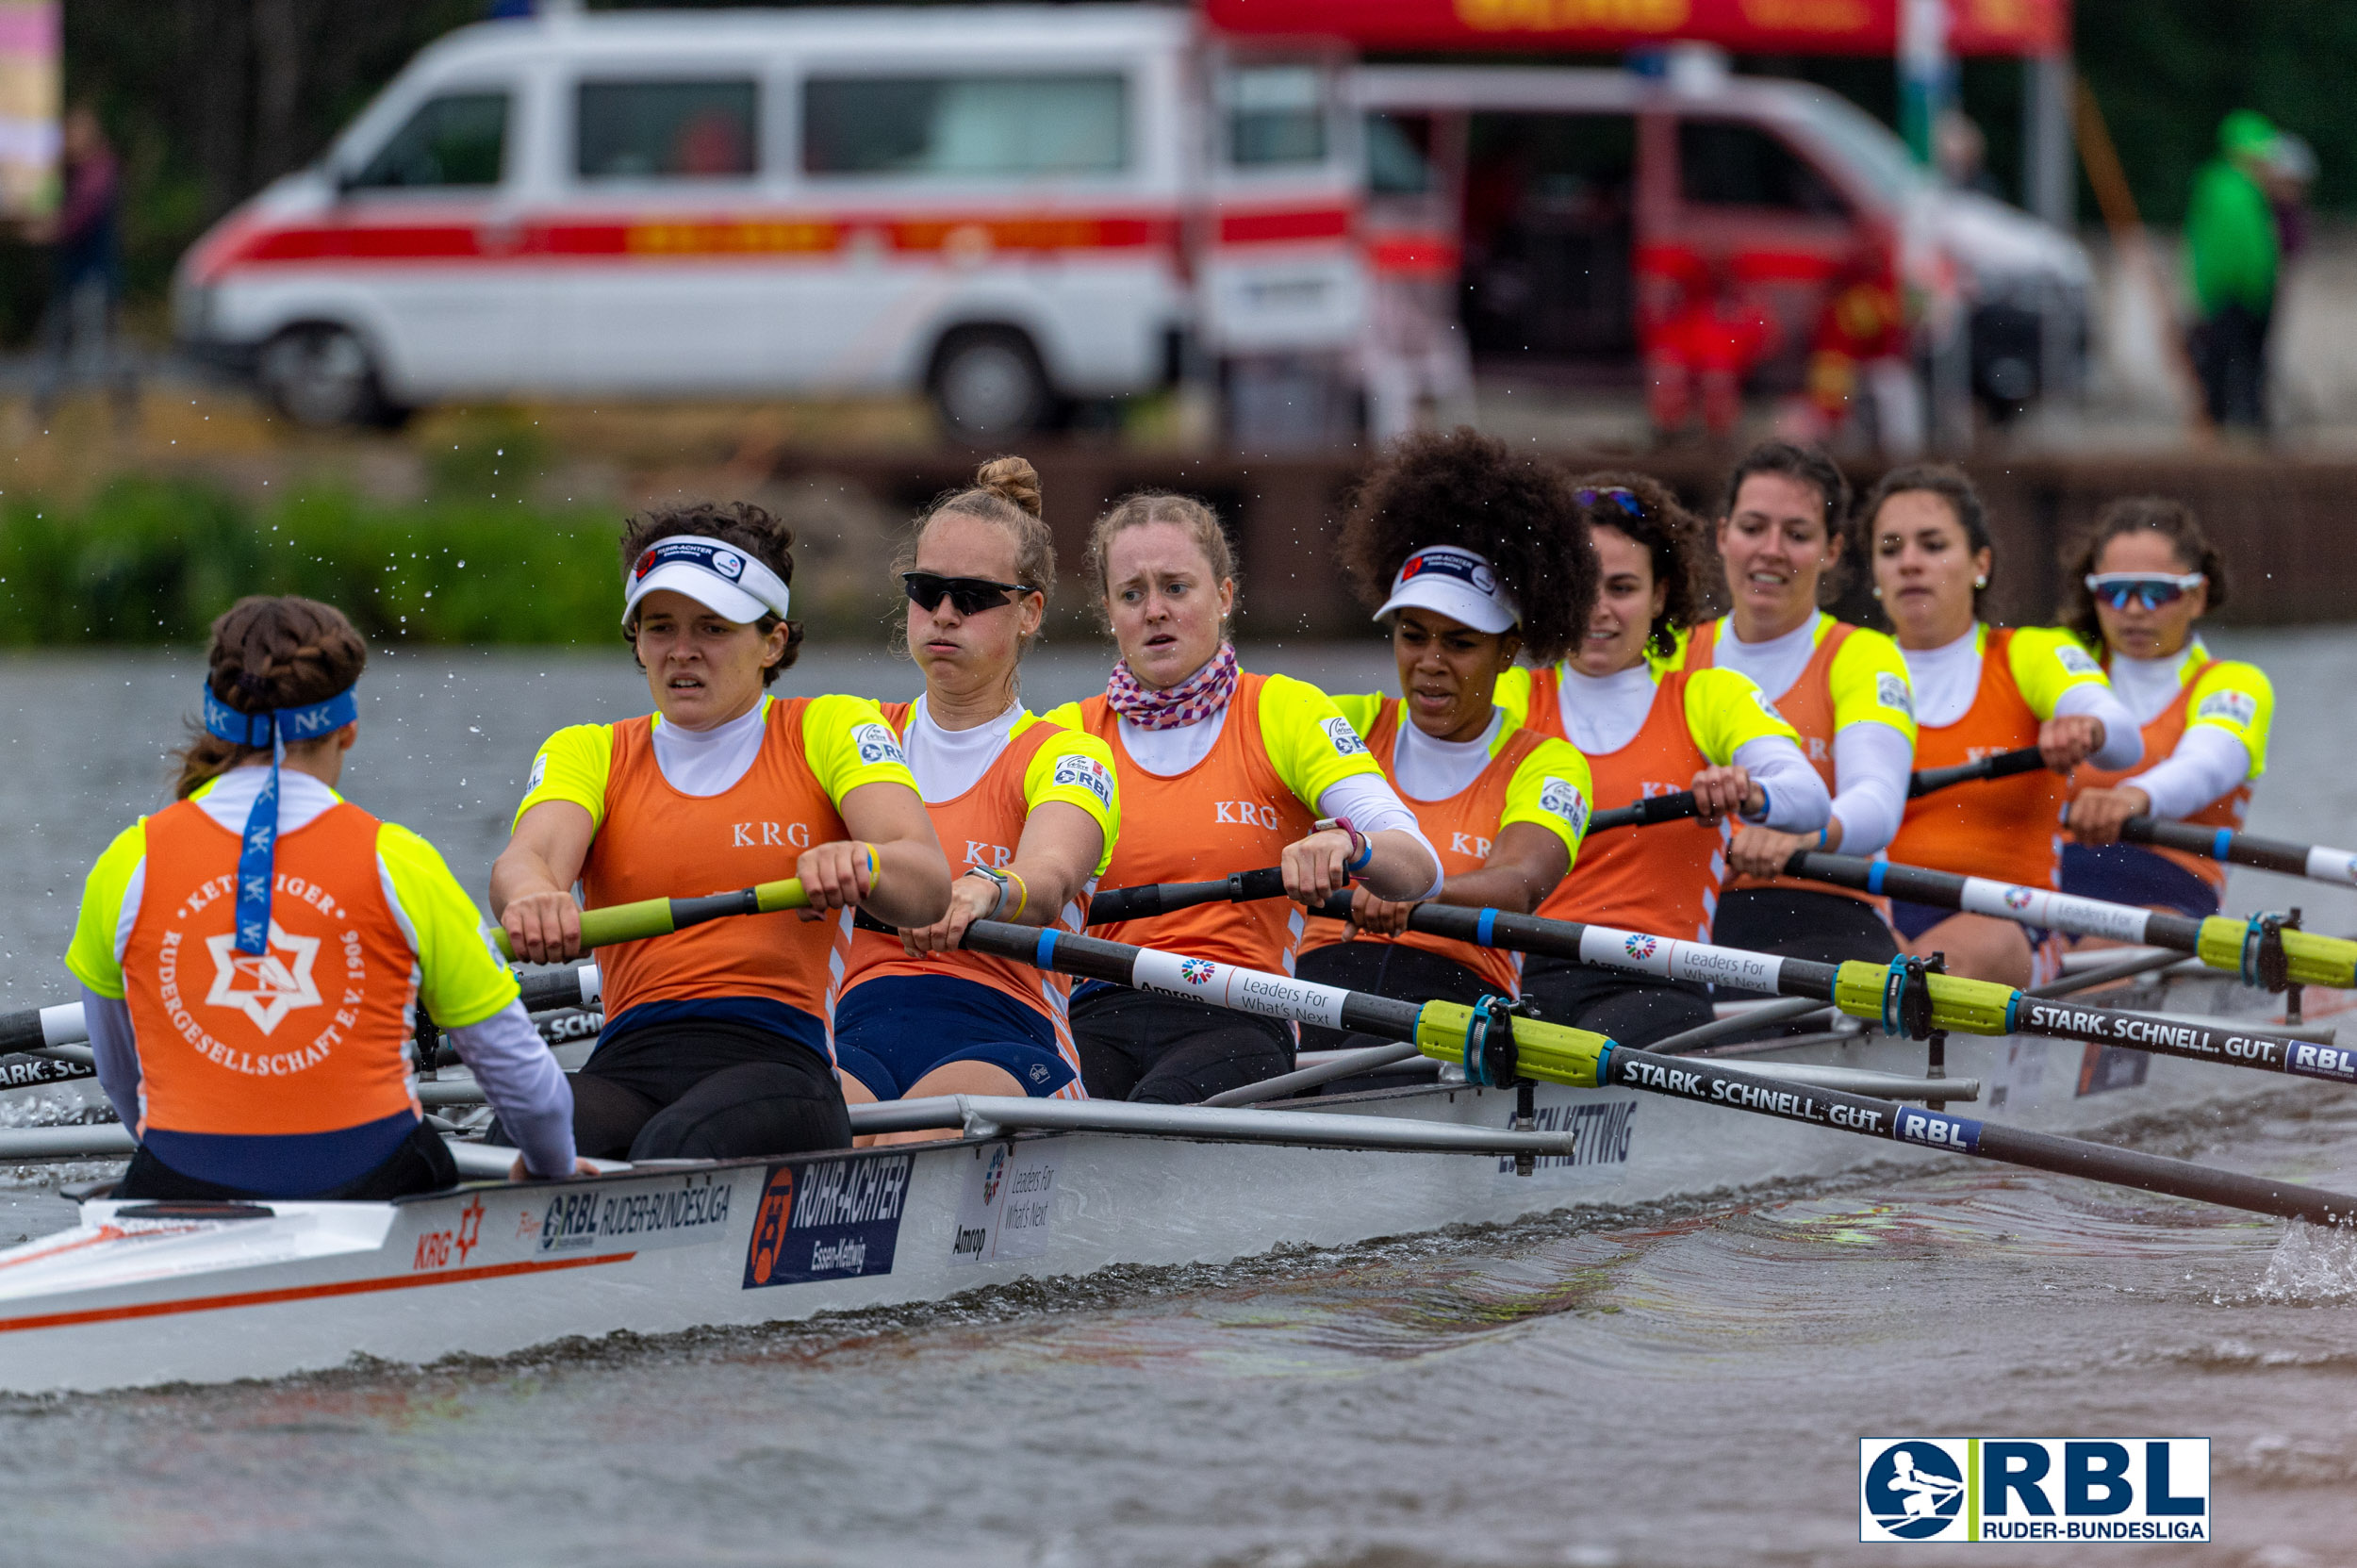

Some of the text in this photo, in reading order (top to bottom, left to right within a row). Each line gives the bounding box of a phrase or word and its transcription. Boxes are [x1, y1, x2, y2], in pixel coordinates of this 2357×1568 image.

[294, 706, 331, 733] NK
[1214, 801, 1278, 831] KRG
[732, 821, 810, 848] KRG
[1449, 831, 1492, 859] KR
[963, 840, 1012, 869] KR
[187, 872, 336, 916] KETIGER
[1684, 950, 1766, 977] Leaders For
[158, 929, 343, 1077] RUDERGESELLSCHAFT
[339, 929, 367, 981] 1906
[1243, 977, 1328, 1008] Leaders For
[1242, 995, 1330, 1026] What's Next
[2031, 1005, 2277, 1063] STARK. SCHNELL. GUT.
[2296, 1044, 2355, 1074] RBL
[1623, 1061, 1885, 1133] STARK. SCHNELL. GUT.
[1904, 1114, 1968, 1148] RBL
[793, 1154, 910, 1229] RUHR-ACHTER
[1012, 1164, 1055, 1195] Leaders For
[560, 1192, 600, 1237] RBL
[599, 1184, 732, 1236] RUDER-BUNDESLIGA
[1005, 1200, 1049, 1230] What's Next
[413, 1230, 453, 1271] KRG
[811, 1236, 866, 1273] Essen-Kettwig
[952, 1224, 986, 1261] Amrop
